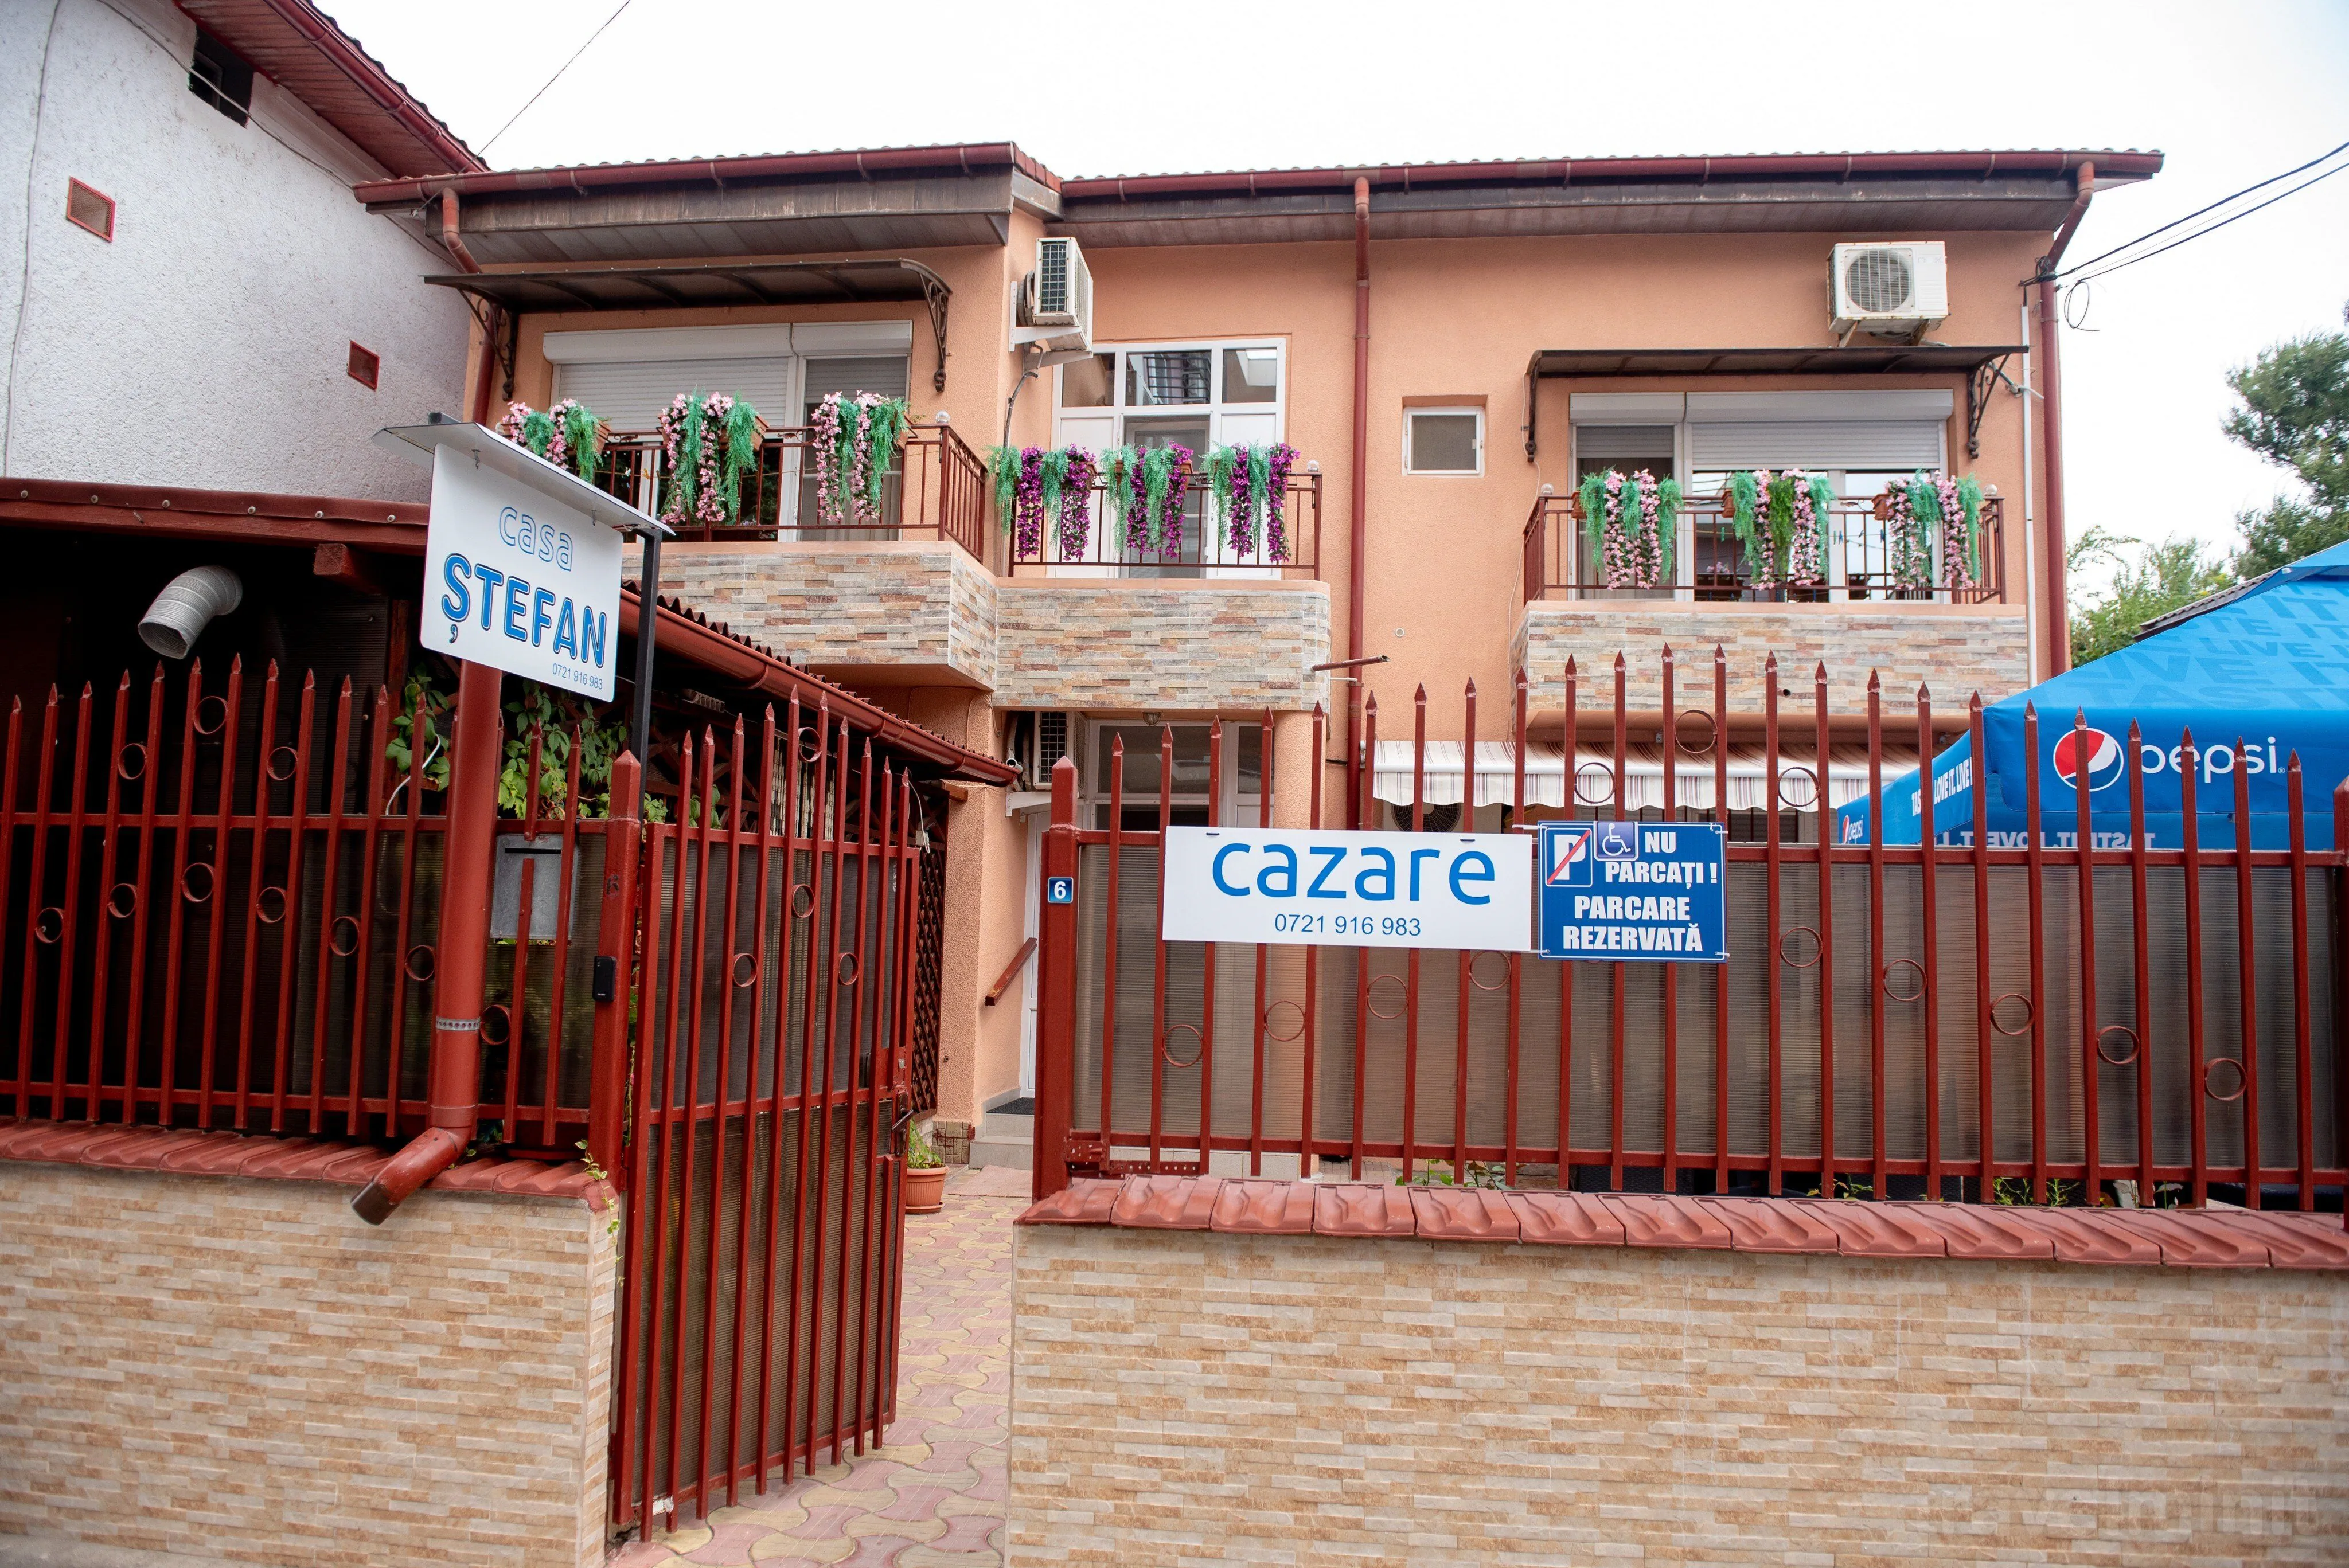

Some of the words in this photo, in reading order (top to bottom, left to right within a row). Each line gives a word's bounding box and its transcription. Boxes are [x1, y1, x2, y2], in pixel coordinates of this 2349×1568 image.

[498, 506, 573, 572] casa
[440, 552, 607, 669] ȘTEFAN
[552, 663, 571, 680] 0721
[573, 670, 587, 685] 916
[590, 675, 603, 690] 983
[1645, 832, 1676, 853] NU
[1848, 814, 1863, 844] pepsi
[1212, 843, 1495, 905] cazare
[1605, 862, 1703, 890] PARCAȚI
[1054, 881, 1066, 900] 6
[1574, 896, 1691, 920] PARCARE
[1274, 914, 1325, 933] 0721
[1335, 916, 1373, 935] 916
[1382, 917, 1421, 936] 983
[1563, 922, 1703, 952] REZERVATĂ
